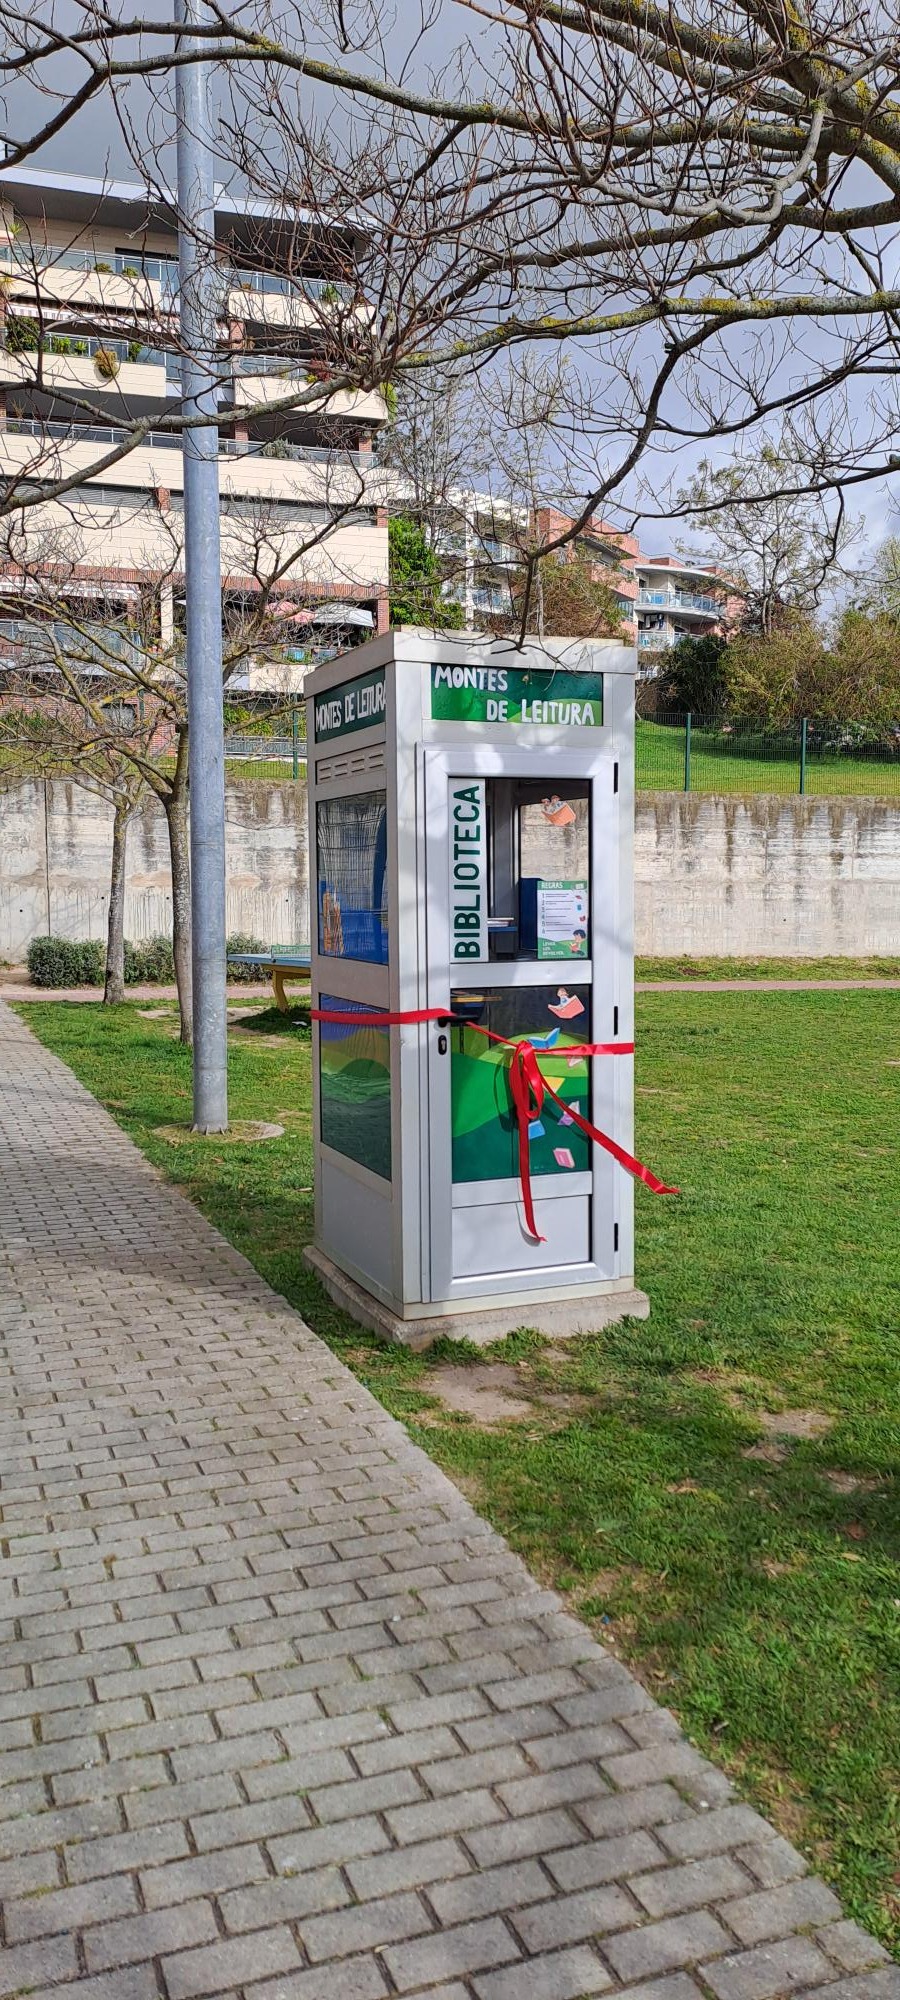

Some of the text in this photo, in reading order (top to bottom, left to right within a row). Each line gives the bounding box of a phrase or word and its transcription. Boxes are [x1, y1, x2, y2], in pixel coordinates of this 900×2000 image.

[434, 665, 508, 692] MONTES
[315, 700, 342, 733] MONTES
[344, 692, 355, 724] DE
[486, 699, 595, 726] DE LEITURA
[453, 785, 481, 958] BIBLIOTECA
